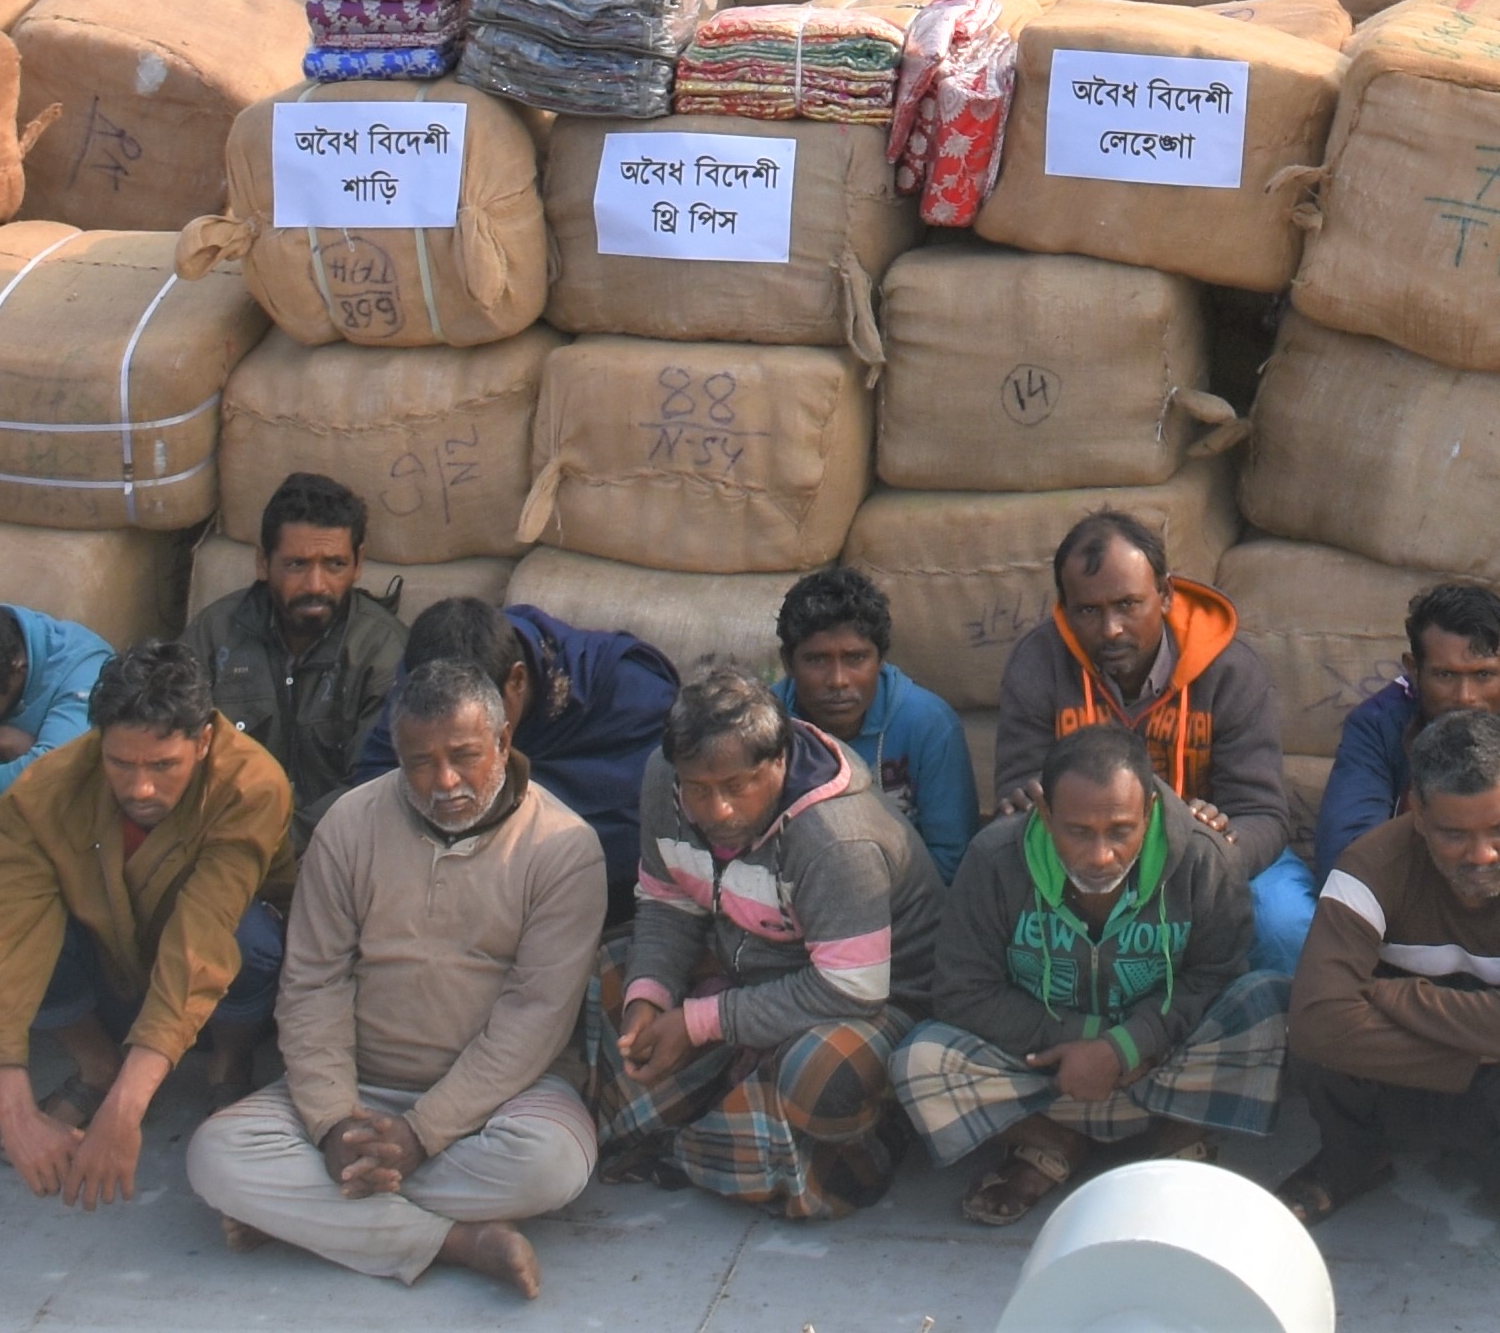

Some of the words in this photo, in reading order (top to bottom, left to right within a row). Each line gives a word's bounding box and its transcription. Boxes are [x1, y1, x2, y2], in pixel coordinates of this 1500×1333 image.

[1071, 75, 1138, 109] অবৈধ
[1145, 76, 1233, 116] বিদেশী
[294, 127, 360, 157] অবৈধ
[366, 124, 449, 160] বিদেশী
[1098, 128, 1197, 161] লেহেঙ্গা
[340, 170, 398, 203] শাড়ি
[620, 156, 685, 188] অবৈধ
[694, 155, 781, 190] বিদেশী
[651, 203, 679, 234] থ্রি
[686, 202, 738, 234] পিস
[657, 366, 737, 424] 88
